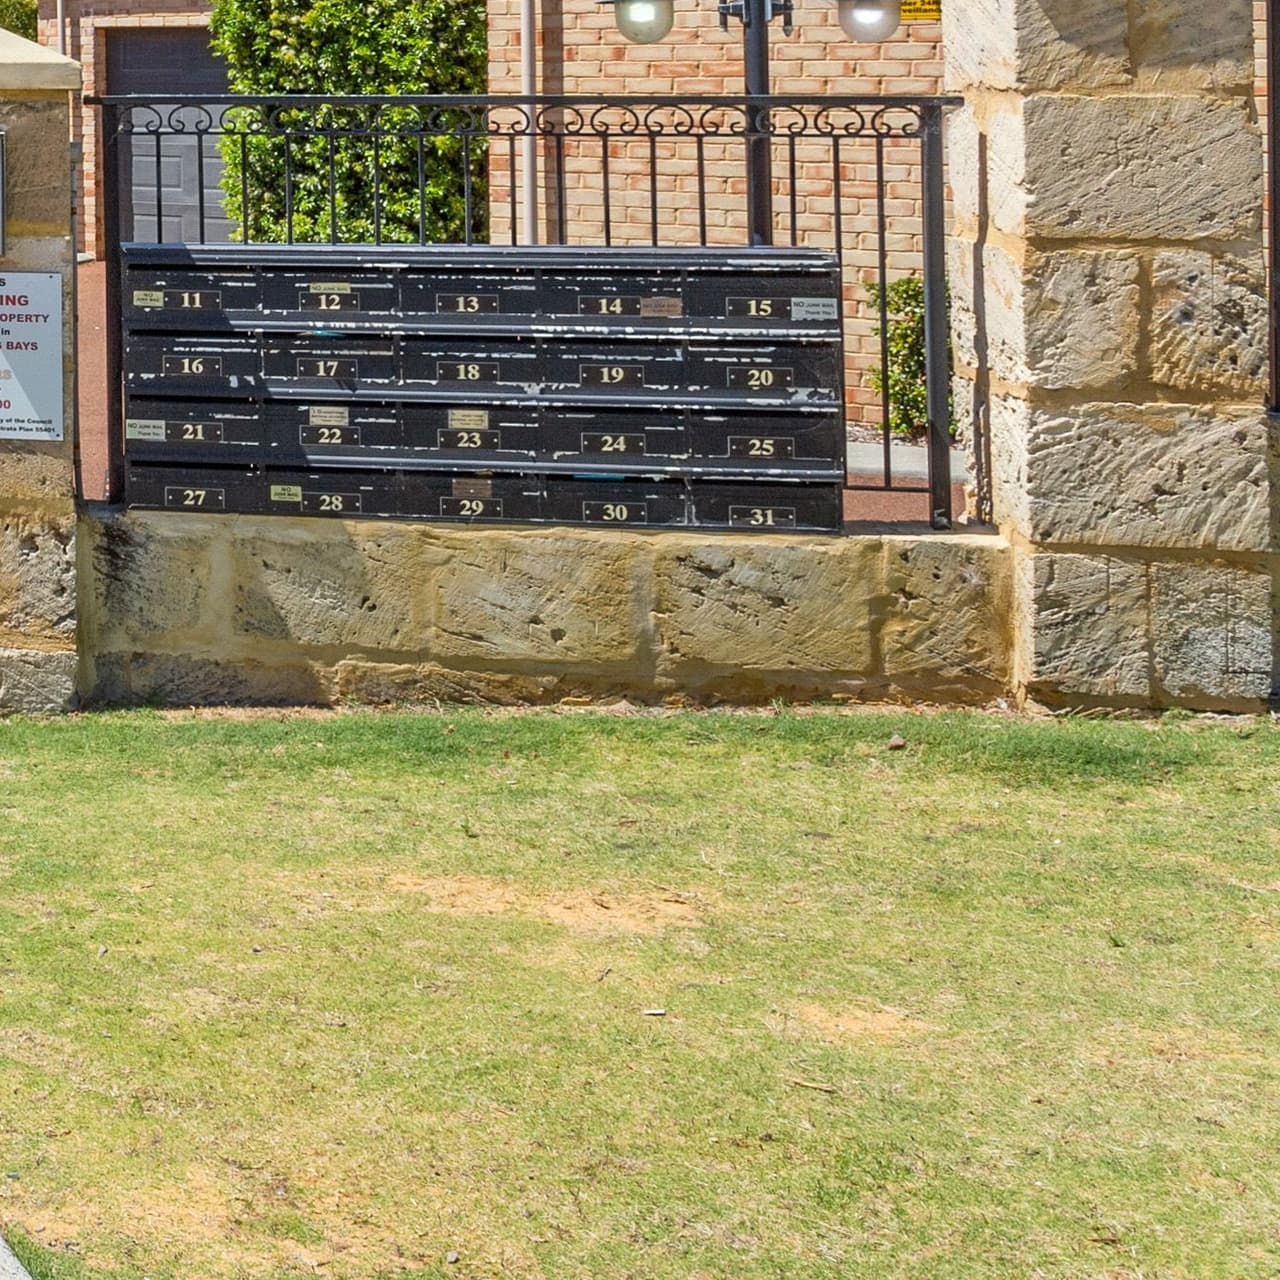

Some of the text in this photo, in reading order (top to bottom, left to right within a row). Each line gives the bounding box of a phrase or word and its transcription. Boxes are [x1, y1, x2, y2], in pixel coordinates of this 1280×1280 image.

[180, 292, 203, 307] 11
[318, 294, 341, 310] 12
[455, 296, 480, 312] 13
[598, 298, 622, 314] 14
[746, 300, 772, 316] 15
[1, 328, 11, 336] in
[6, 341, 39, 351] BAYS
[180, 358, 204, 374] 16
[316, 361, 339, 376] 17
[456, 364, 480, 380] 18
[600, 368, 624, 383] 19
[748, 370, 773, 386] 20
[182, 424, 204, 440] 21
[318, 428, 342, 444] 22
[457, 432, 482, 448] 23
[601, 436, 626, 452] 24
[749, 440, 774, 456] 25
[183, 490, 206, 506] 27
[320, 495, 343, 511] 28
[460, 500, 484, 516] 29
[602, 504, 628, 520] 30
[750, 510, 776, 526] 31
